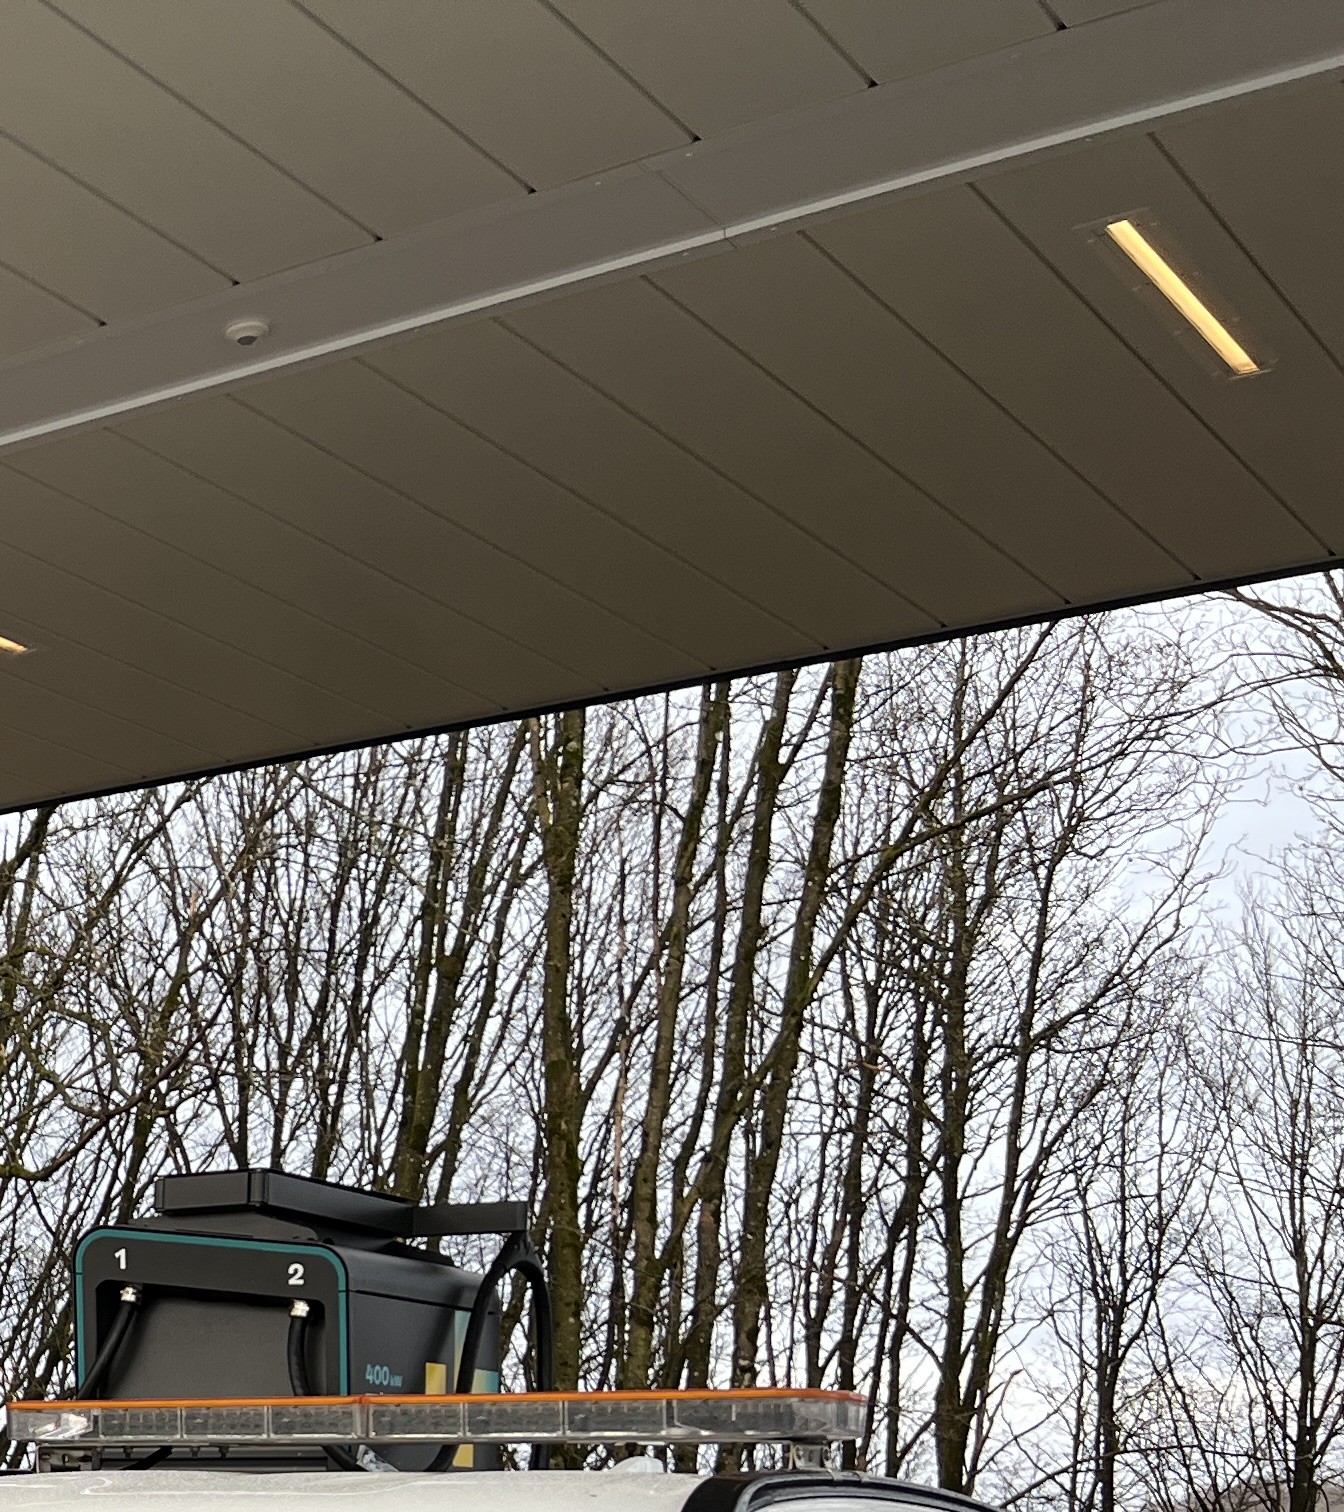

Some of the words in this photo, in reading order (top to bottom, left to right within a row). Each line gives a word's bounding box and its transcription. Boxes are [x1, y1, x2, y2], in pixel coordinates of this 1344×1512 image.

[114, 1248, 126, 1270] 1
[287, 1263, 305, 1286] 2
[365, 1363, 389, 1386] 400
